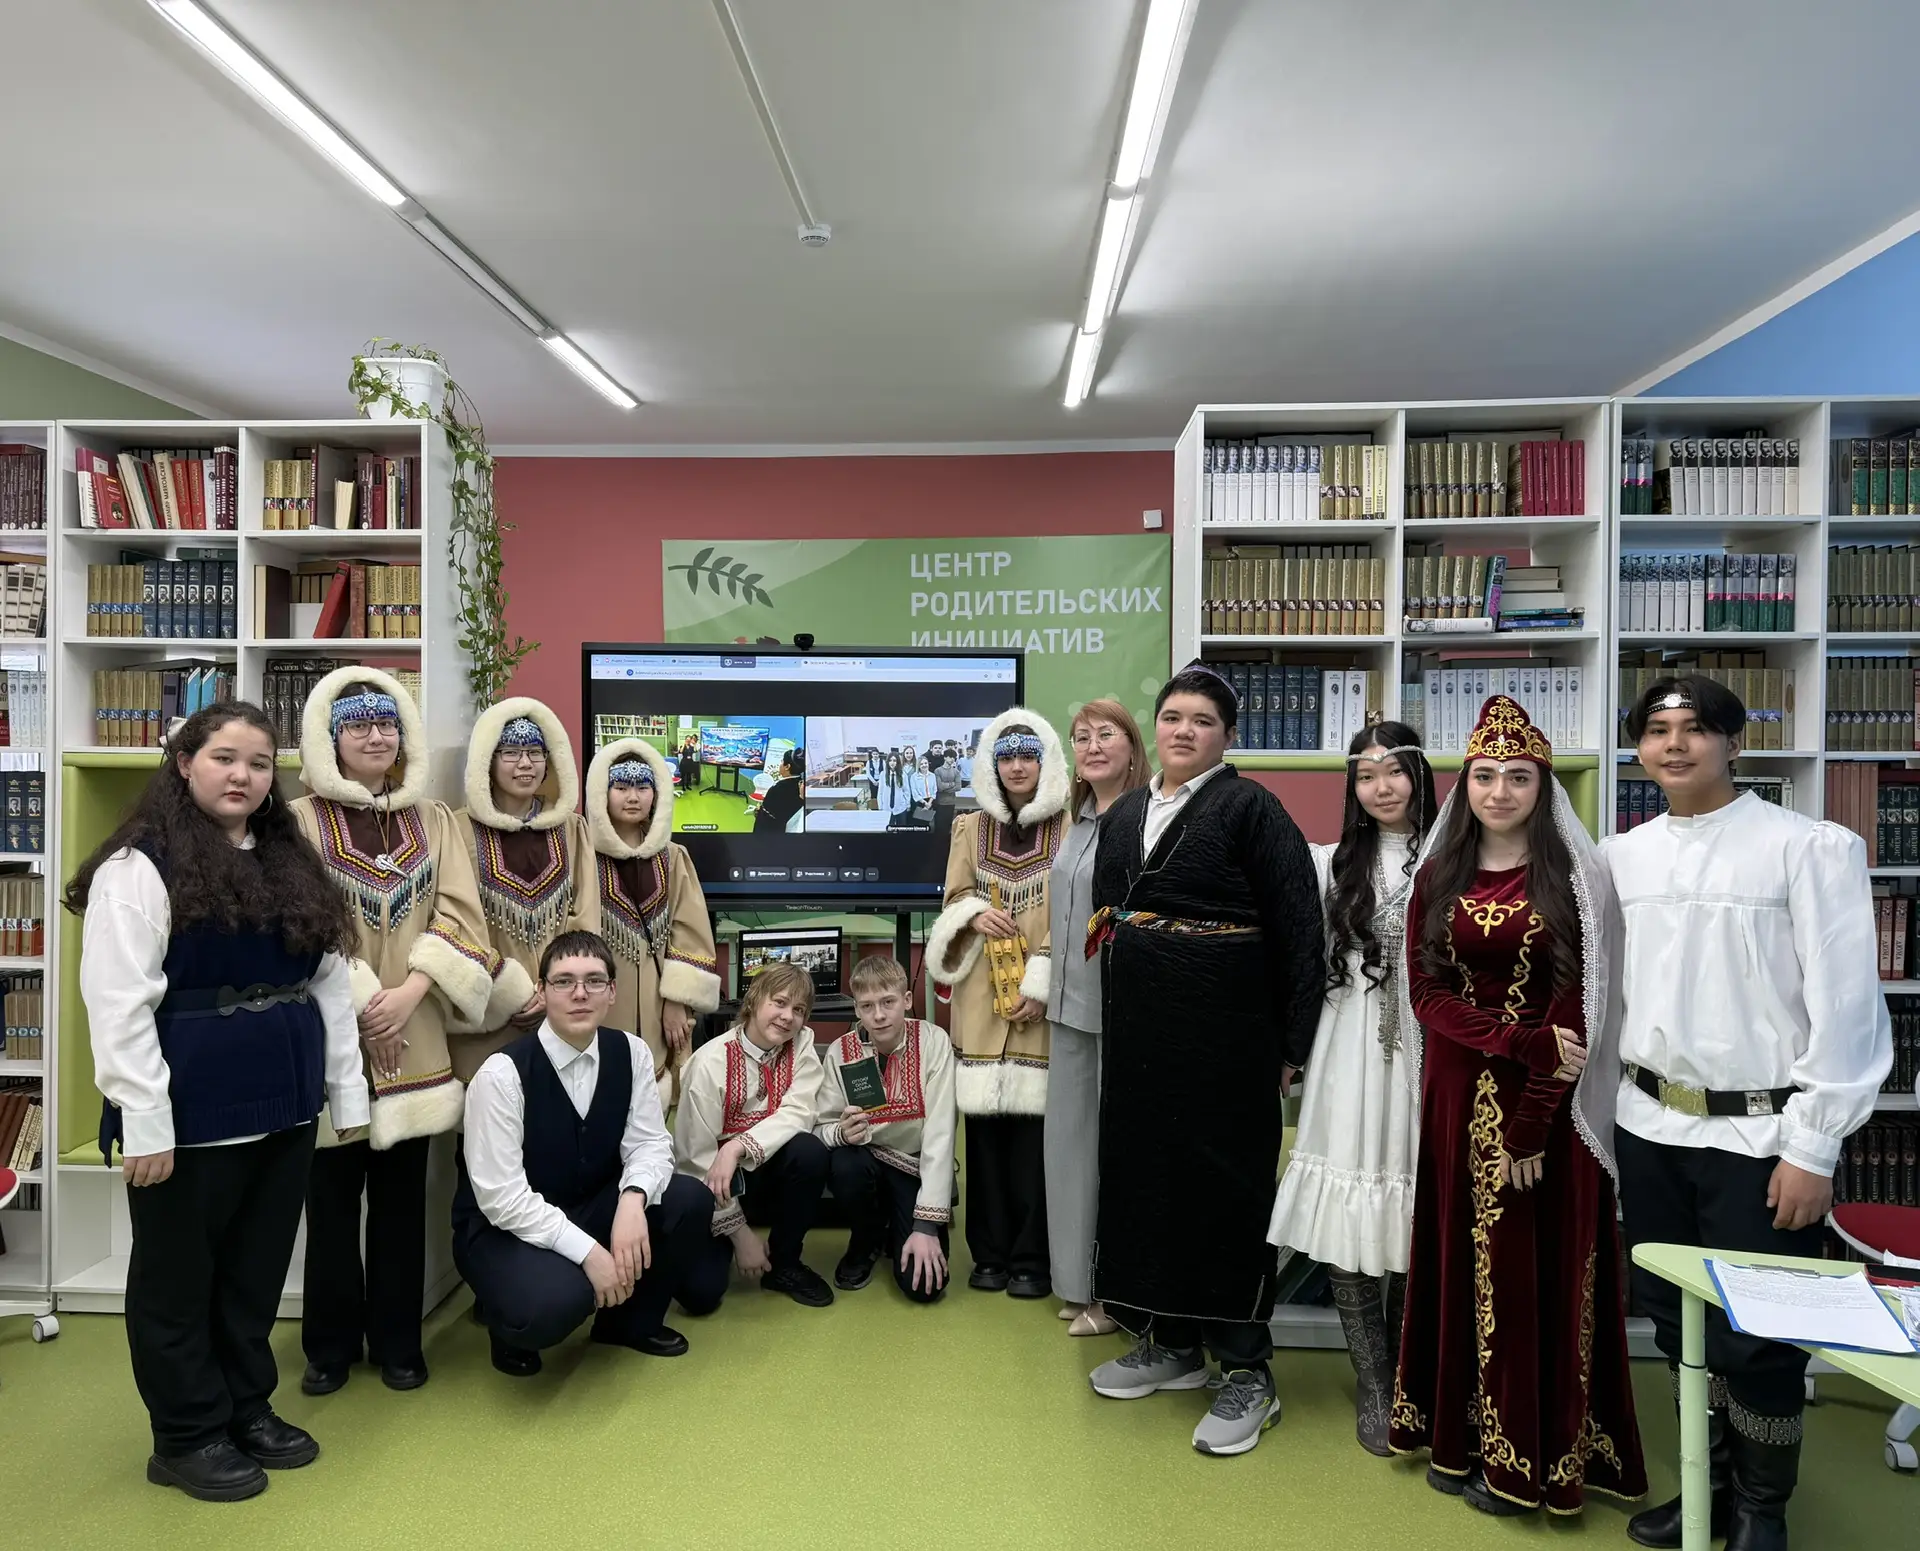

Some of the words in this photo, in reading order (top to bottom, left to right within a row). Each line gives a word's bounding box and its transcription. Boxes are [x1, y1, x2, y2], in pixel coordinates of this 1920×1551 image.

[160, 461, 171, 499] МАЯКОВСКИЙ
[911, 552, 1012, 582] ЦЕНТР
[911, 587, 1162, 620] РОДИТЕЛЬСКИХ
[911, 628, 1104, 653] ИНИЦИАТИВ
